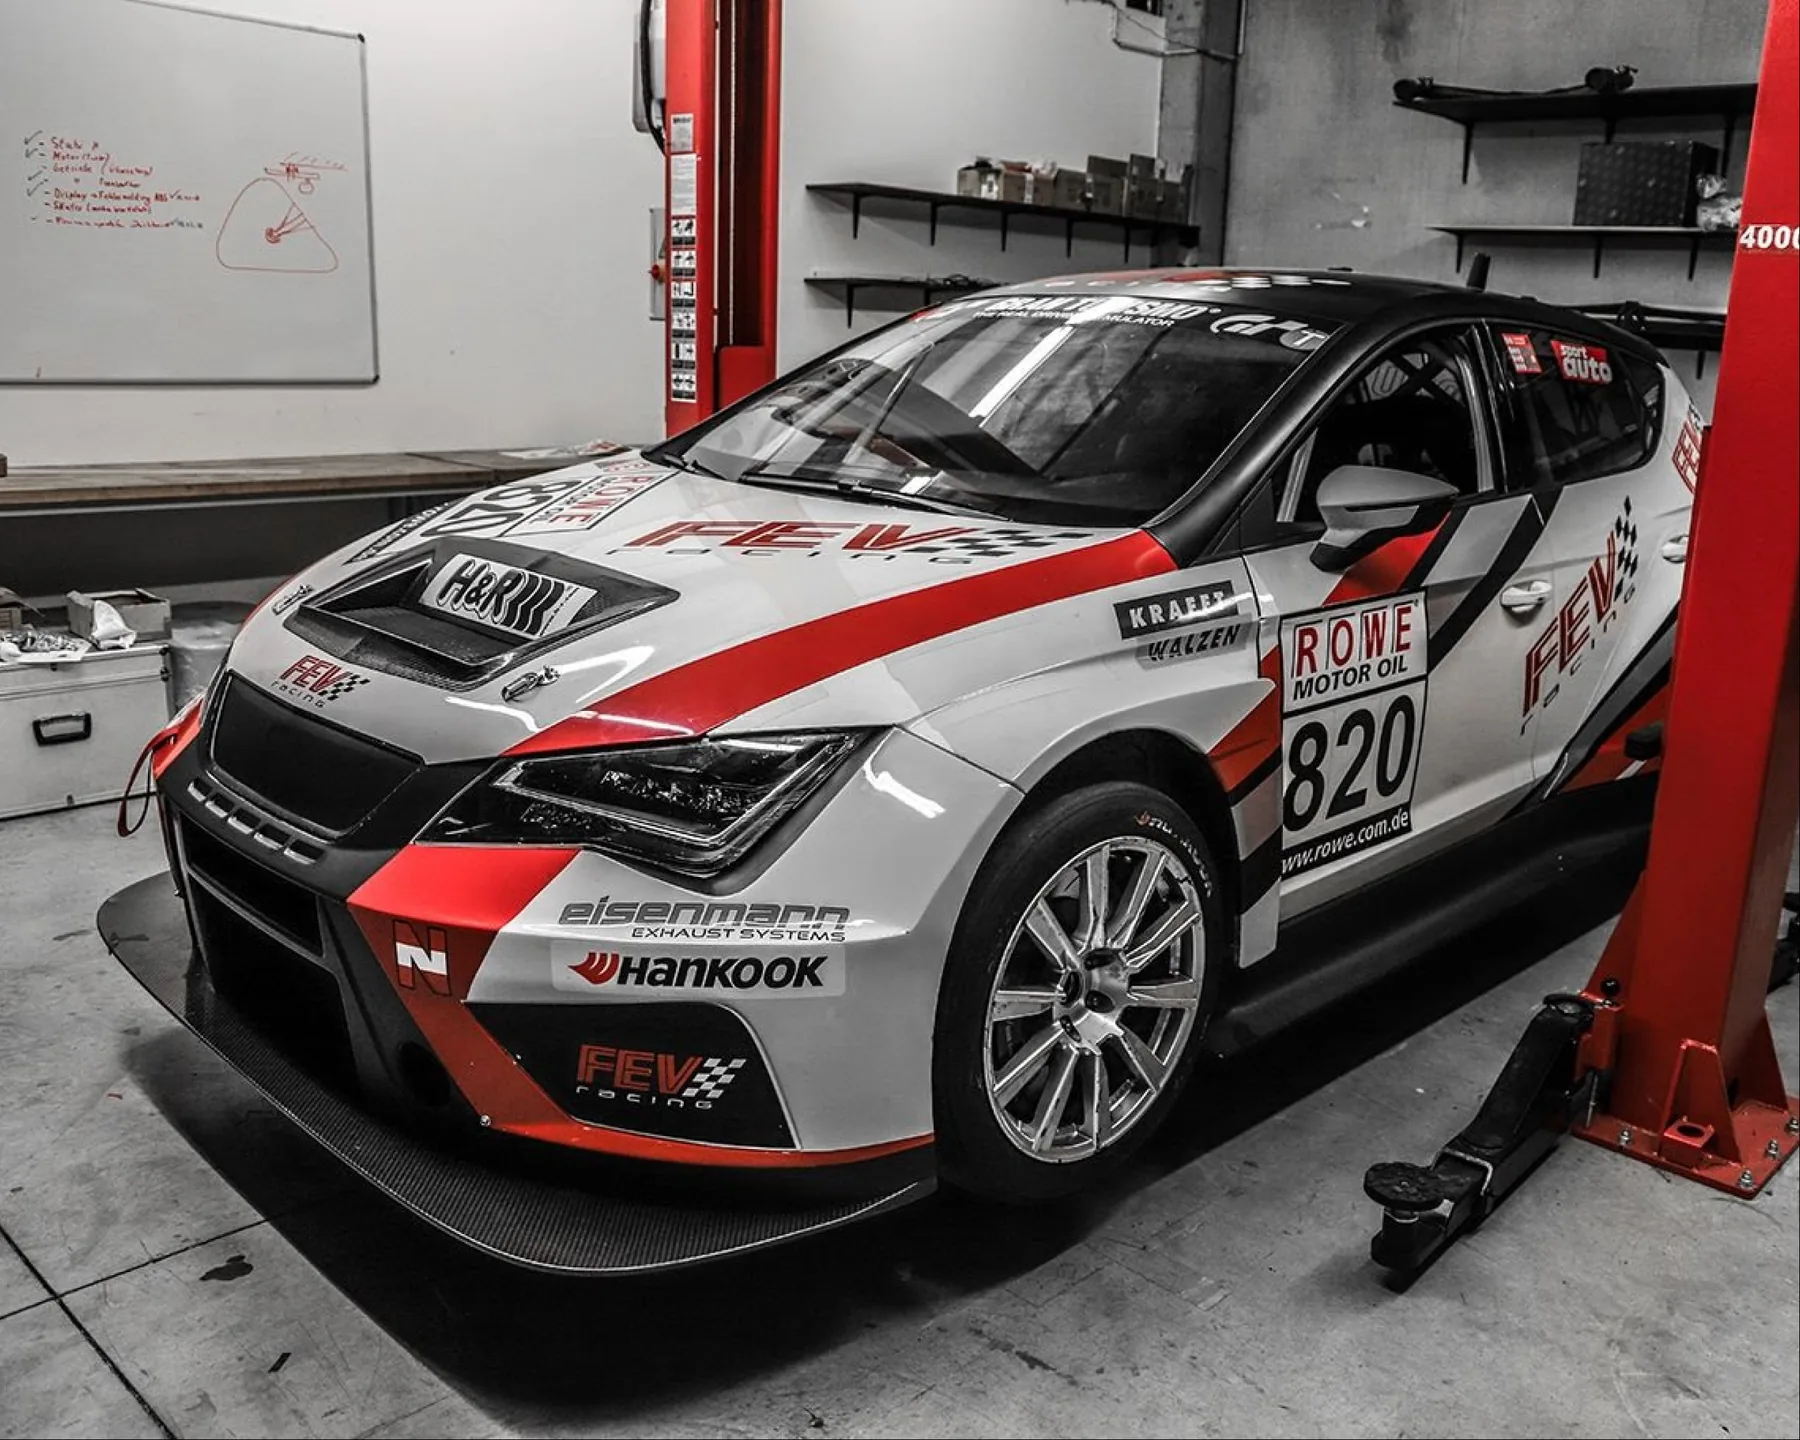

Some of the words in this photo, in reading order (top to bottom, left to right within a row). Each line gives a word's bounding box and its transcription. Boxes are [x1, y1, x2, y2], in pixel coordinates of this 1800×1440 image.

[1562, 356, 1613, 384] auto
[624, 520, 984, 550] FEV
[436, 558, 528, 625] H&R
[1294, 604, 1413, 678] ROWE
[1522, 530, 1617, 718] FEV
[1148, 633, 1241, 661] WALZEN
[279, 655, 354, 693] FEV
[1293, 663, 1372, 701] MOTOR
[1377, 655, 1409, 679] OIL
[1283, 694, 1416, 833] 820
[1281, 808, 1410, 875] ww.rowe.com.de
[558, 895, 850, 930] eisenmann
[631, 927, 735, 939] EXHAUST
[739, 928, 846, 943] SYSTEMS
[576, 1044, 704, 1096] FEV
[575, 1085, 713, 1110] racing
